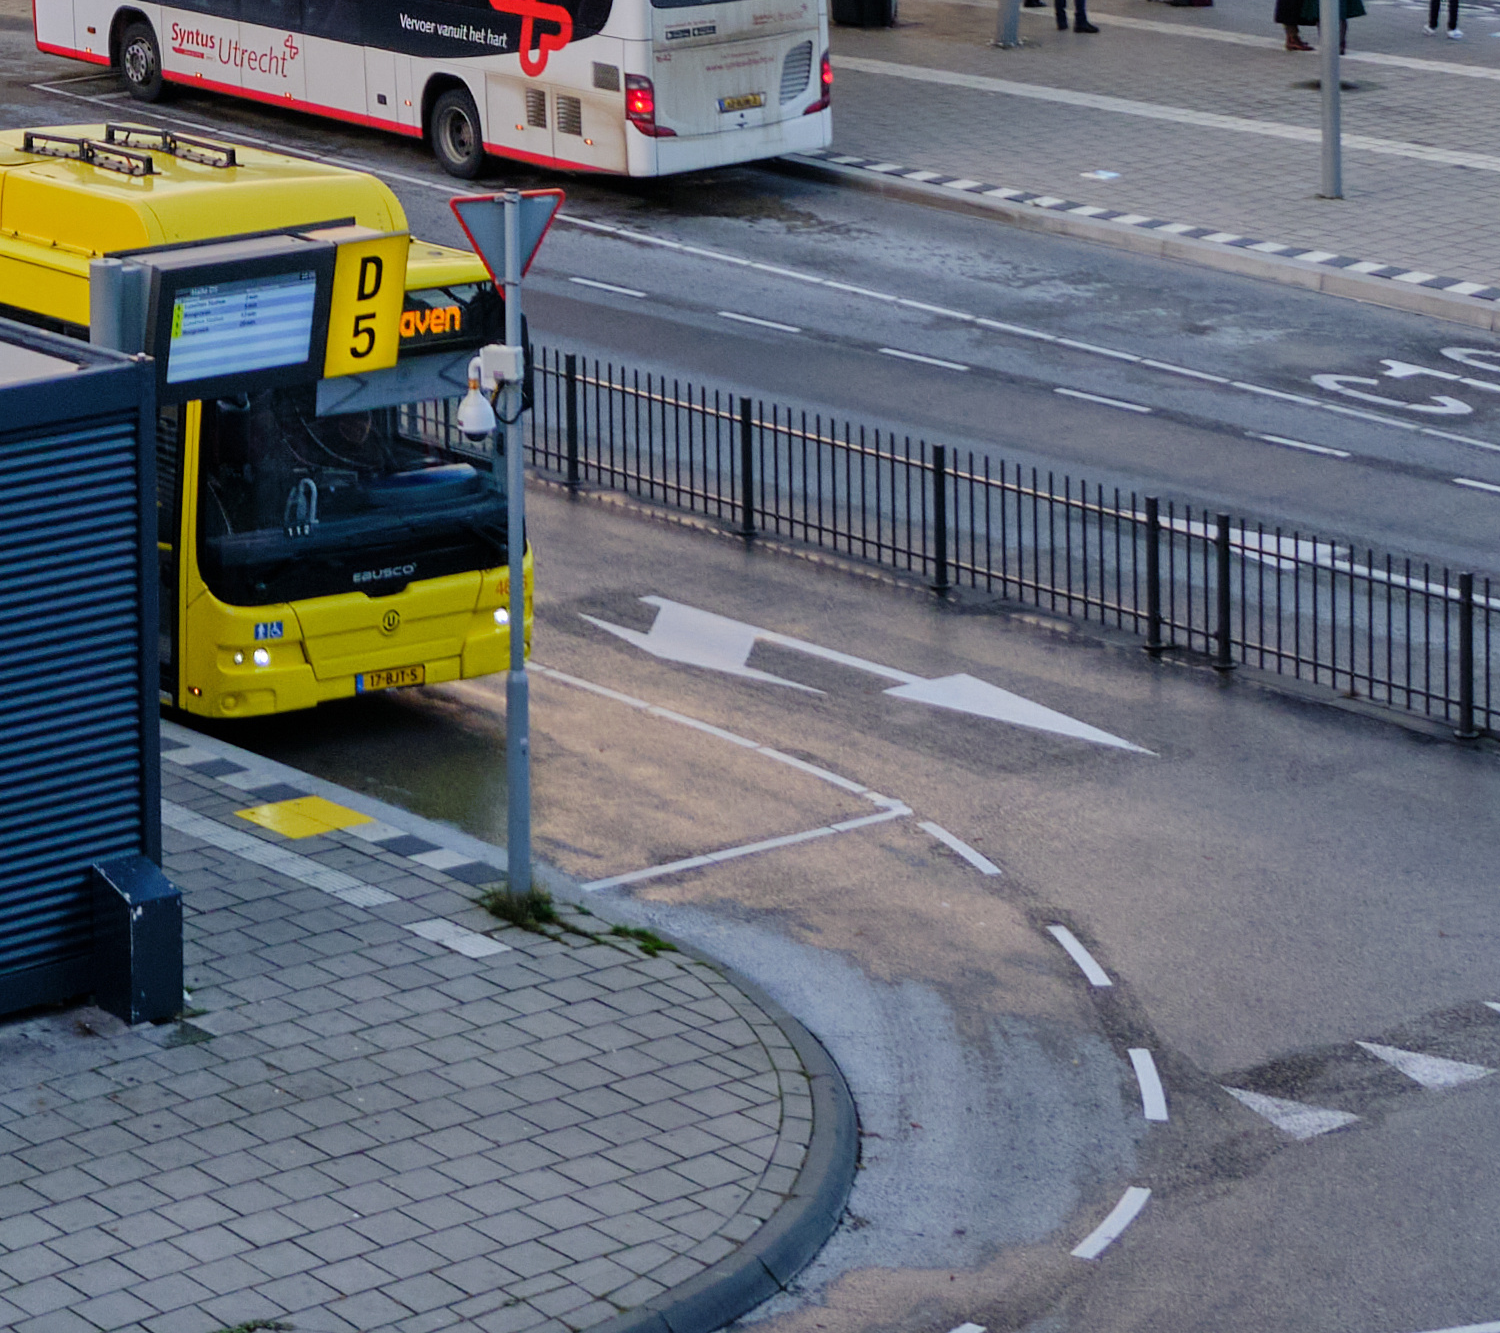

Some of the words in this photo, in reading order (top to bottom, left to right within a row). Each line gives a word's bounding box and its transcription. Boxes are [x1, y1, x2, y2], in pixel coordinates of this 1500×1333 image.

[171, 22, 215, 49] Syntus
[218, 37, 287, 78] Utrecht
[400, 13, 436, 34] Vervoer
[437, 23, 468, 41] vanuit
[469, 26, 485, 44] het
[487, 31, 508, 49] hart
[356, 255, 384, 301] D
[349, 312, 377, 359] 5
[400, 305, 462, 338] aven
